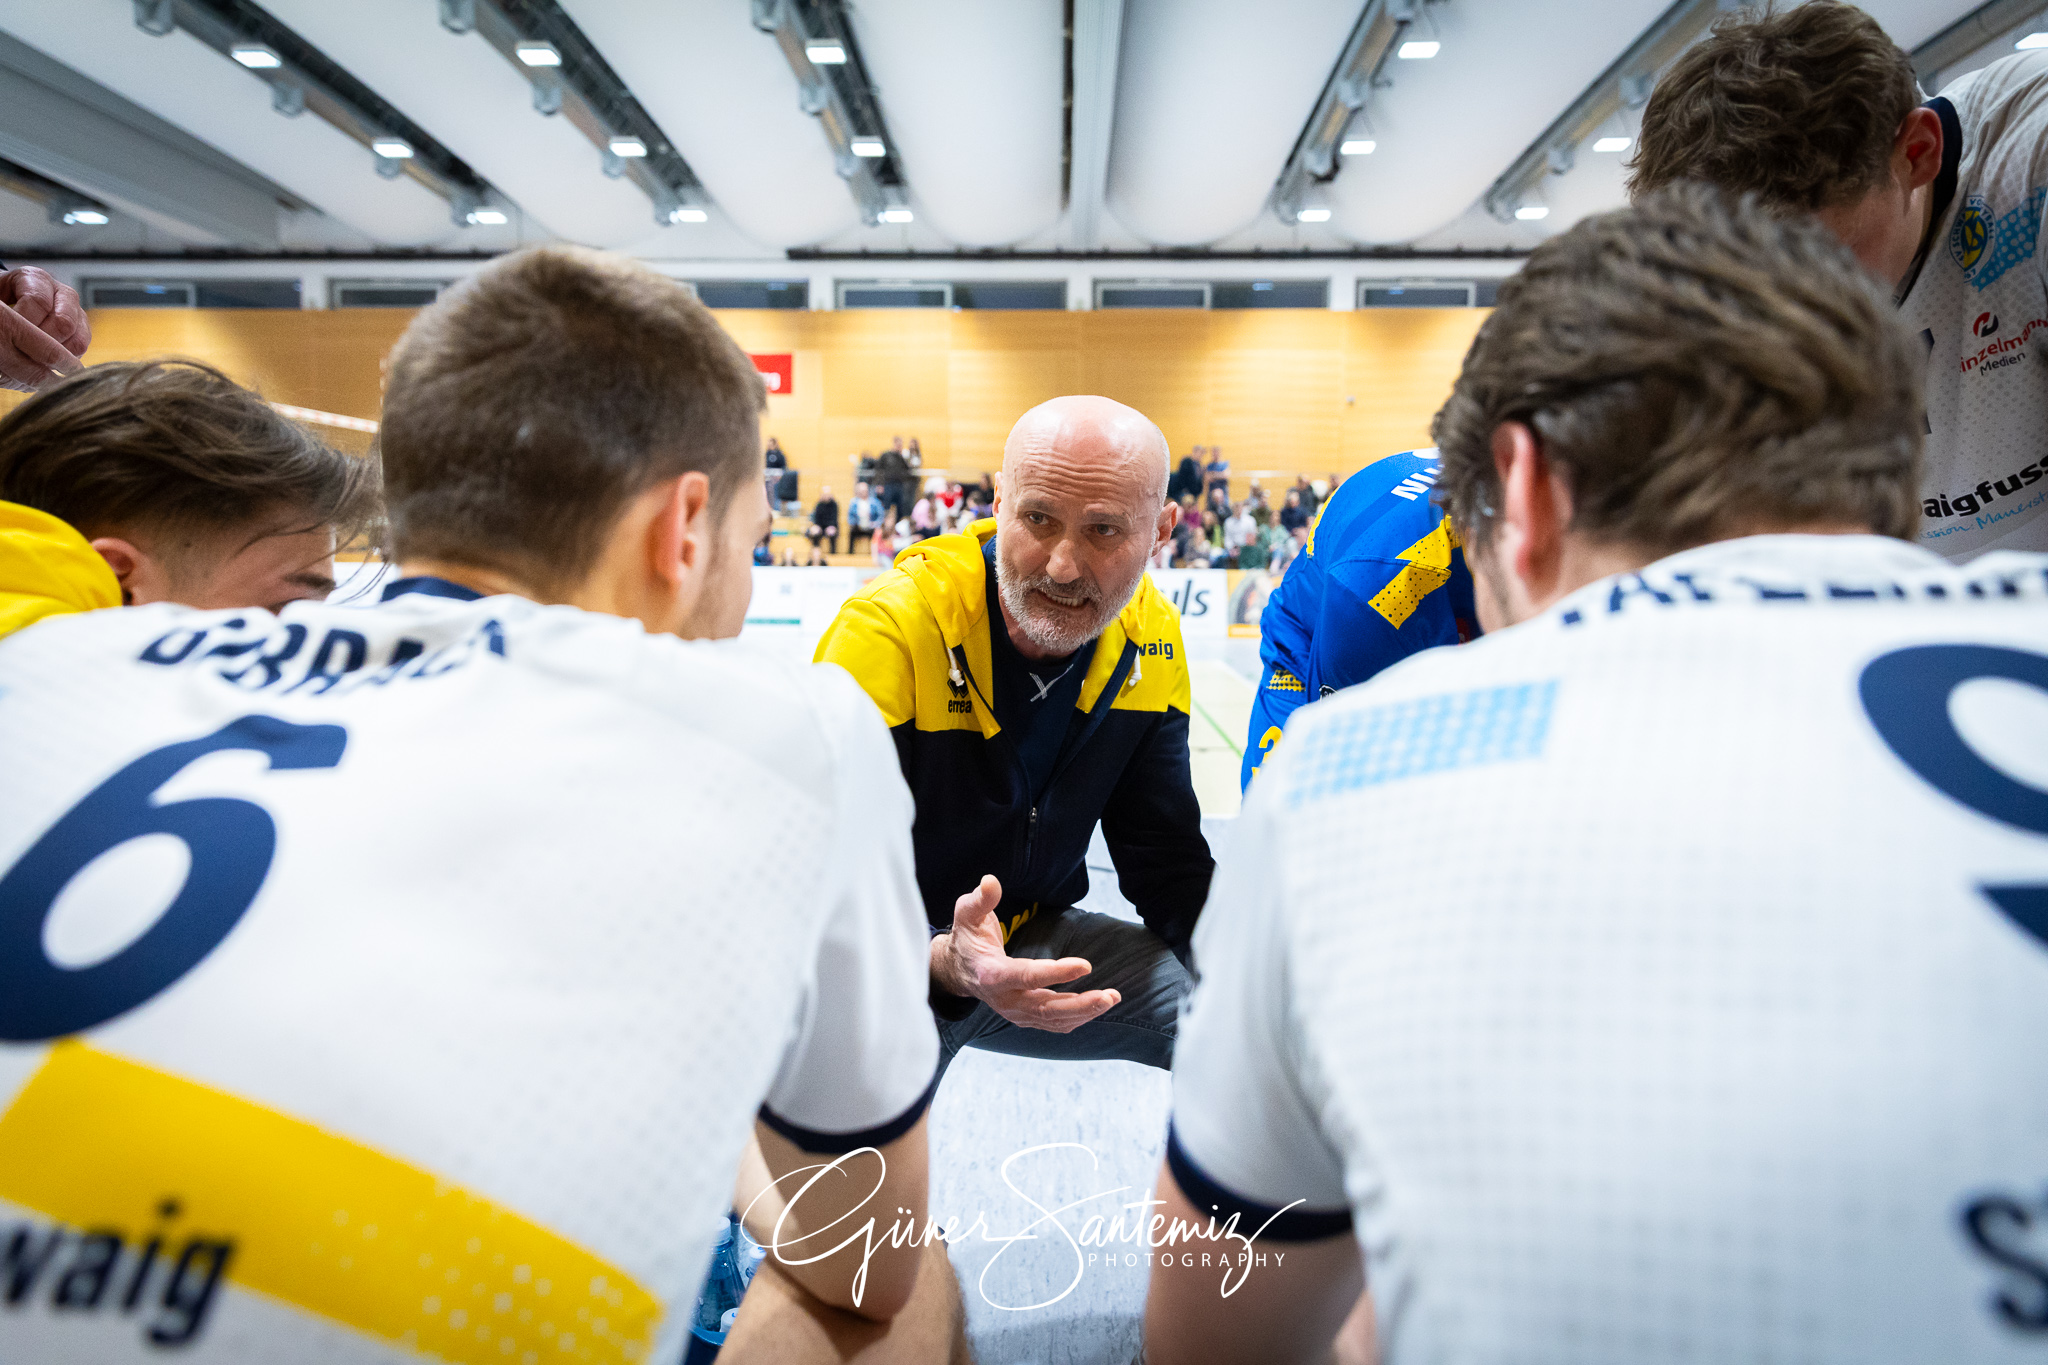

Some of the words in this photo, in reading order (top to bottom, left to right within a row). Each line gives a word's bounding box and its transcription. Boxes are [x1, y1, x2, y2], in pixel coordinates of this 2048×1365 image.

[1960, 318, 2048, 372] inzelmann
[1980, 352, 2026, 376] Medien
[1921, 455, 2048, 518] aigfus
[1975, 490, 2048, 530] Mauerst
[0, 713, 348, 1043] 6
